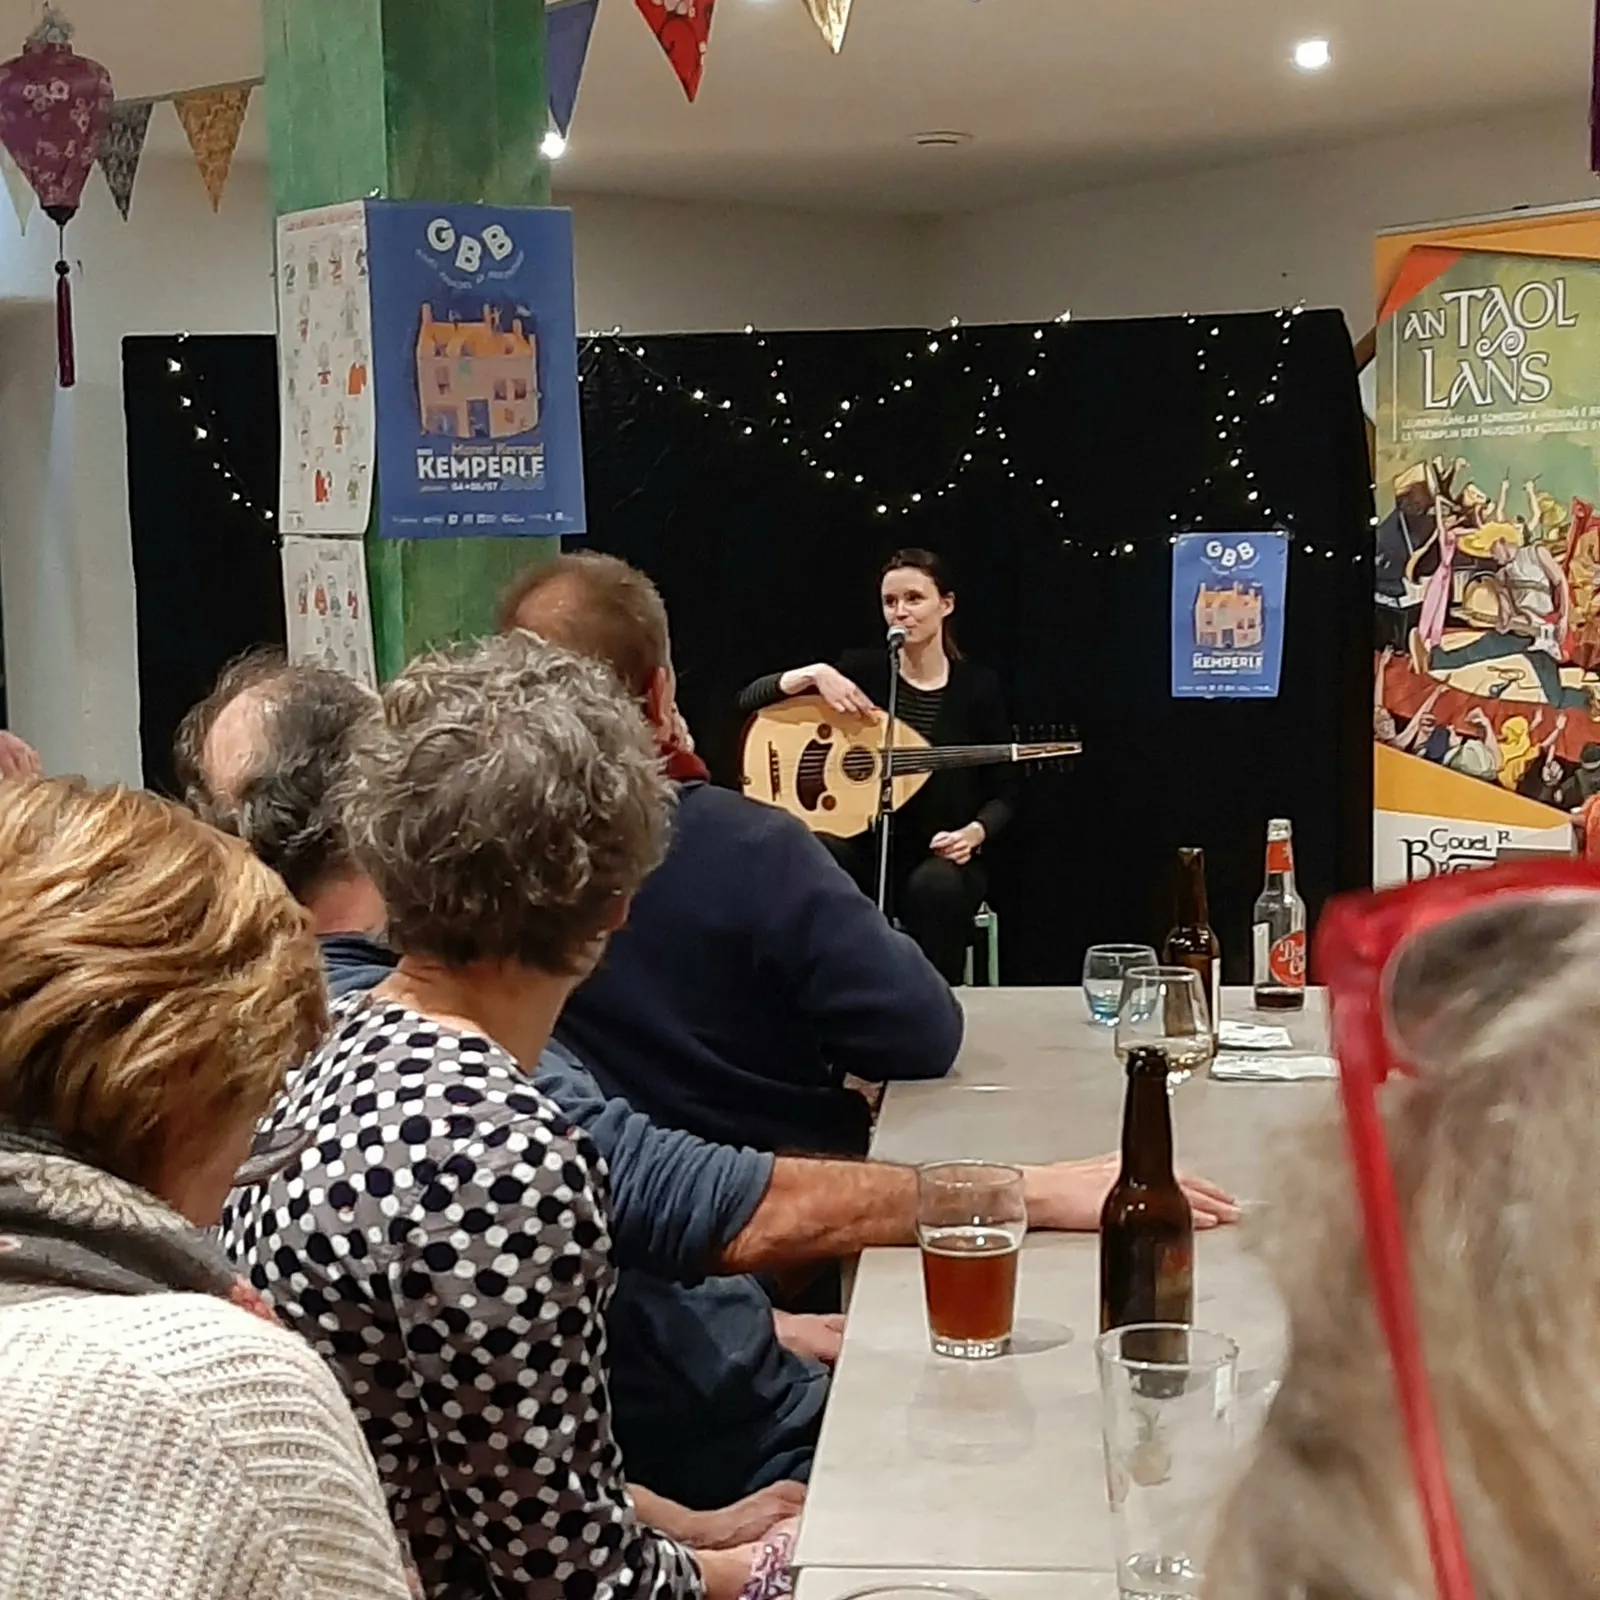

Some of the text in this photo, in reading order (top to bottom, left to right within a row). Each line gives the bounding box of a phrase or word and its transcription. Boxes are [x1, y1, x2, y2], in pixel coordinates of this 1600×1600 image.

[427, 218, 513, 272] GBB
[1404, 277, 1579, 358] AN TAOL
[1419, 347, 1551, 409] LANS
[417, 456, 545, 479] KEMPERLE
[1206, 540, 1255, 567] GBB
